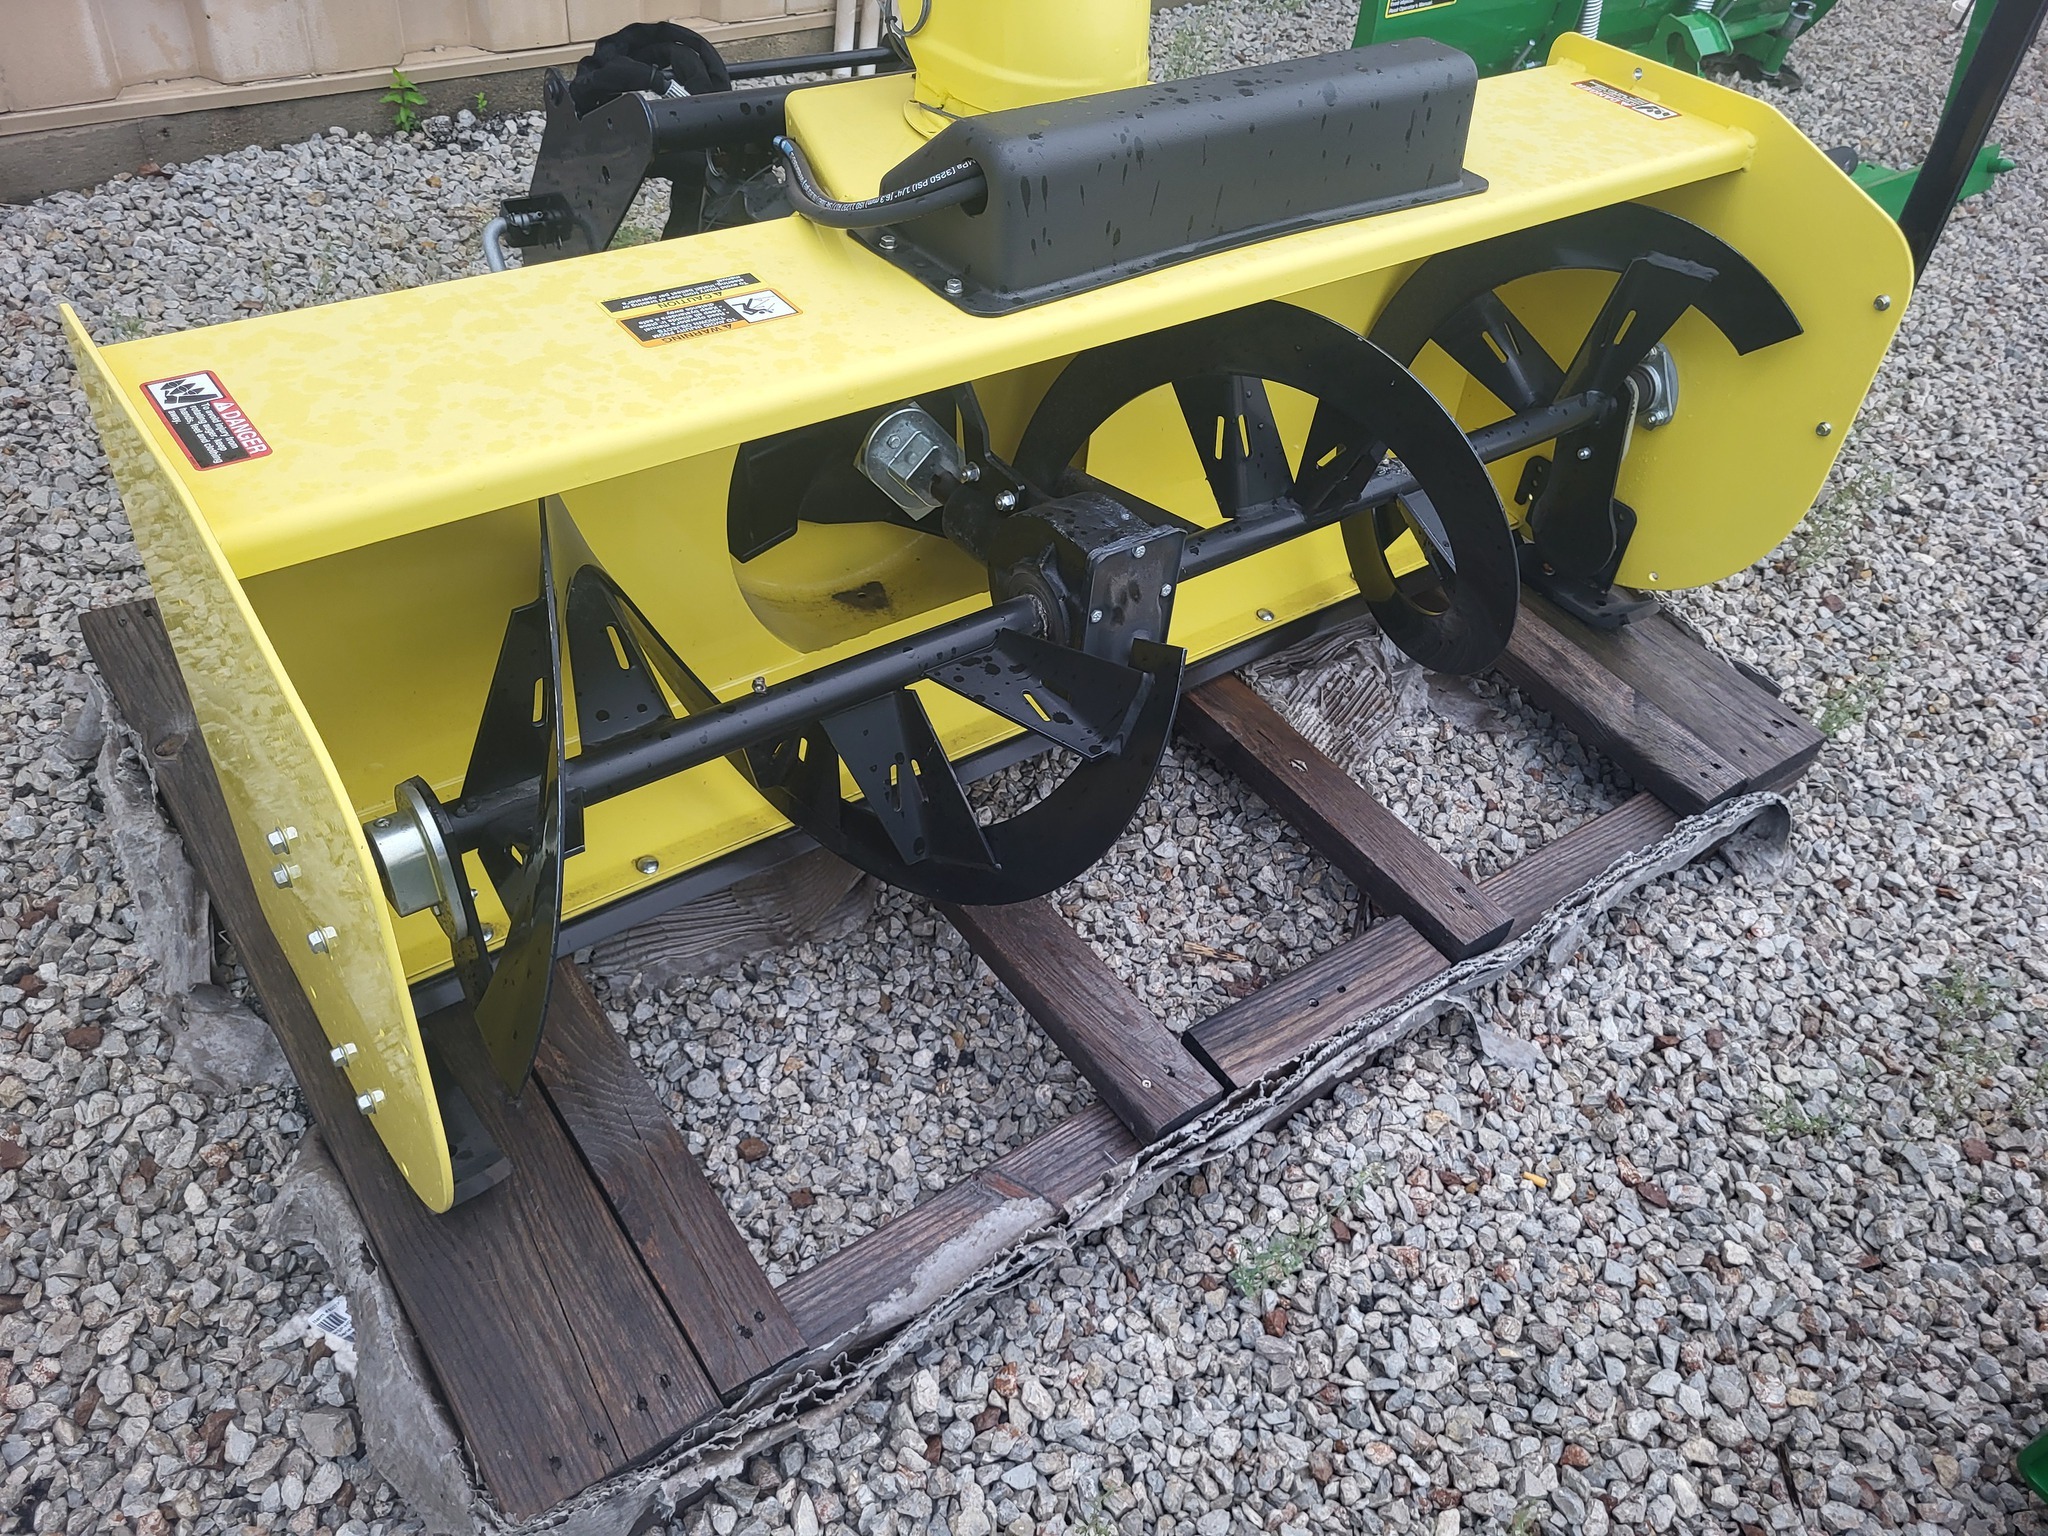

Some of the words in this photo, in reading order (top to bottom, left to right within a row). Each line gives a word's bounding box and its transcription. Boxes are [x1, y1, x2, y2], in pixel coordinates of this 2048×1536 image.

[912, 179, 929, 193] PSI)
[930, 169, 956, 187] (3250
[657, 294, 714, 308] CAUTION
[660, 326, 722, 343] WARNING
[168, 410, 182, 424] away.
[201, 402, 211, 413] To
[207, 410, 221, 426] avoid
[214, 424, 231, 438] injury
[226, 436, 238, 449] from
[179, 407, 194, 425] hands,
[190, 424, 201, 435] feet
[197, 433, 208, 444] and
[204, 443, 223, 464] clothing
[190, 405, 207, 424] rotating
[203, 422, 217, 439] auger,
[215, 439, 227, 451] keep
[223, 410, 267, 455] DANGER
